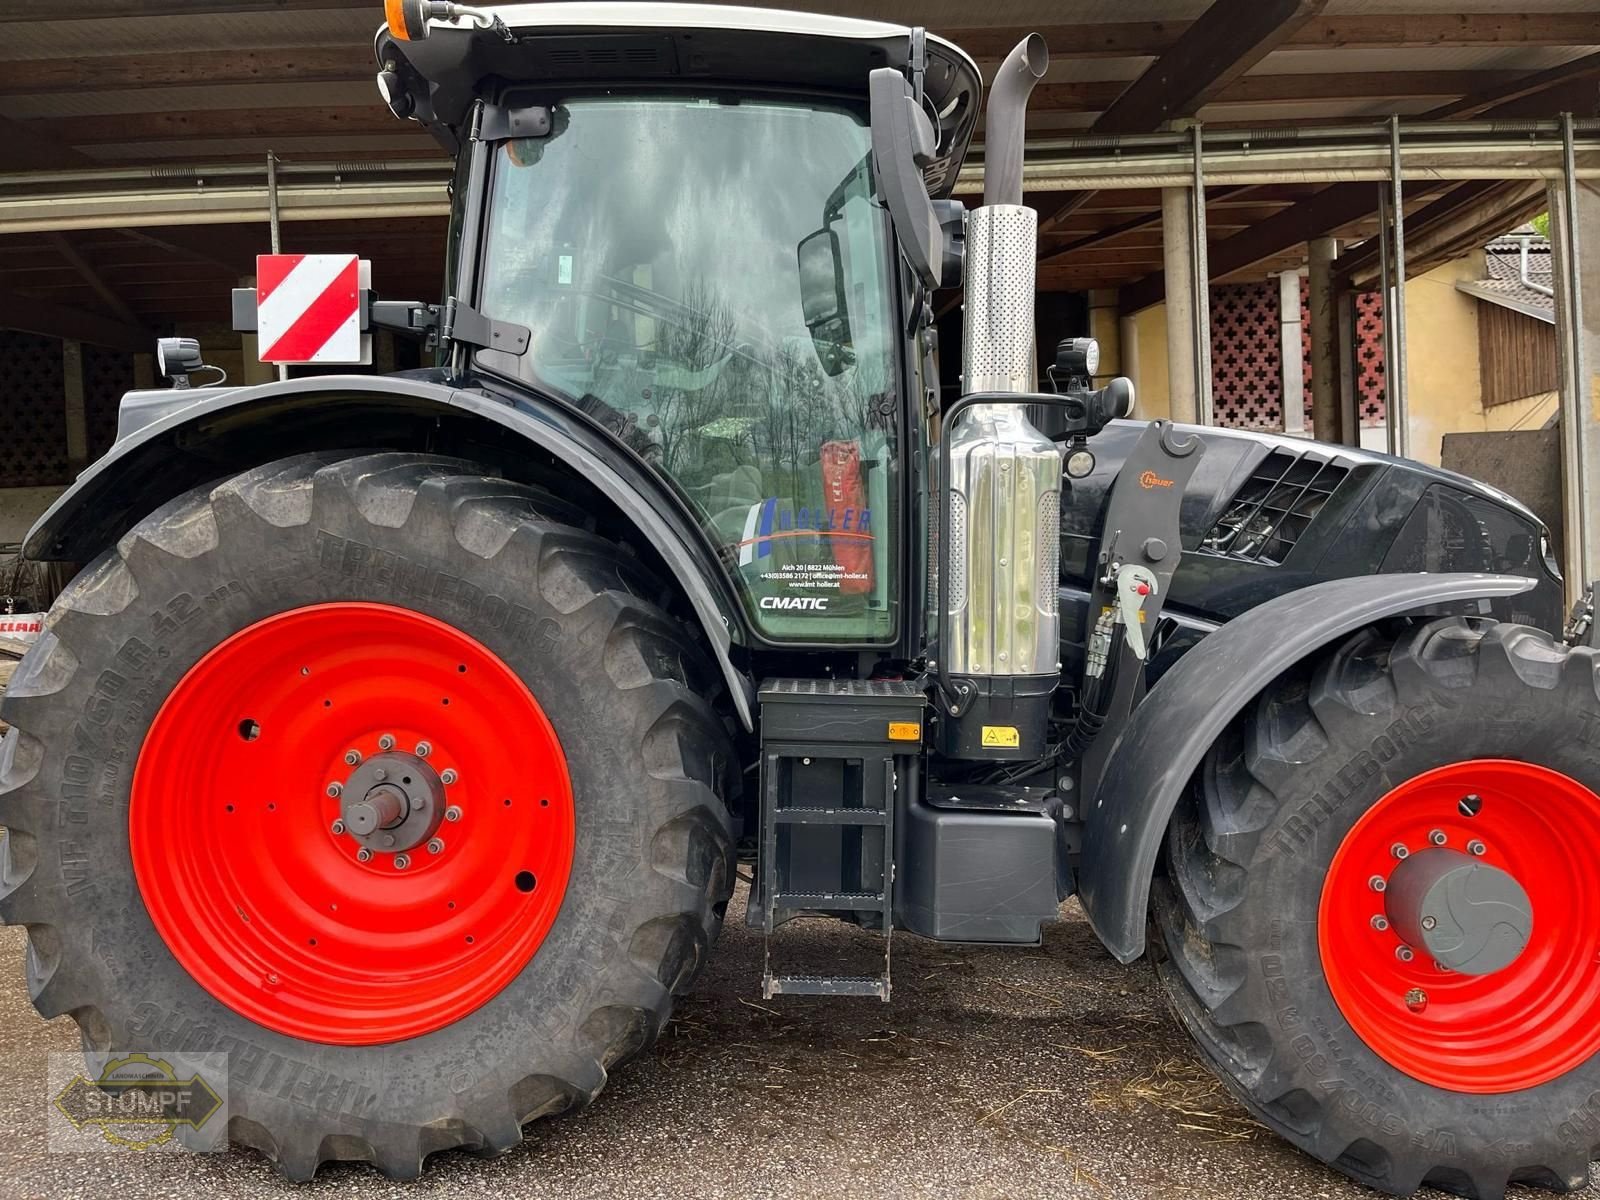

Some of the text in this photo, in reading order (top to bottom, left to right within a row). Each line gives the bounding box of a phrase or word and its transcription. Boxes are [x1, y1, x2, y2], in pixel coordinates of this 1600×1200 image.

[780, 508, 873, 531] HOLLER
[796, 564, 804, 572] 20
[316, 529, 562, 654] TRELLEBORG
[760, 596, 829, 609] CMATIC
[150, 592, 204, 642] 42
[1265, 703, 1436, 859] TRELLEBORG
